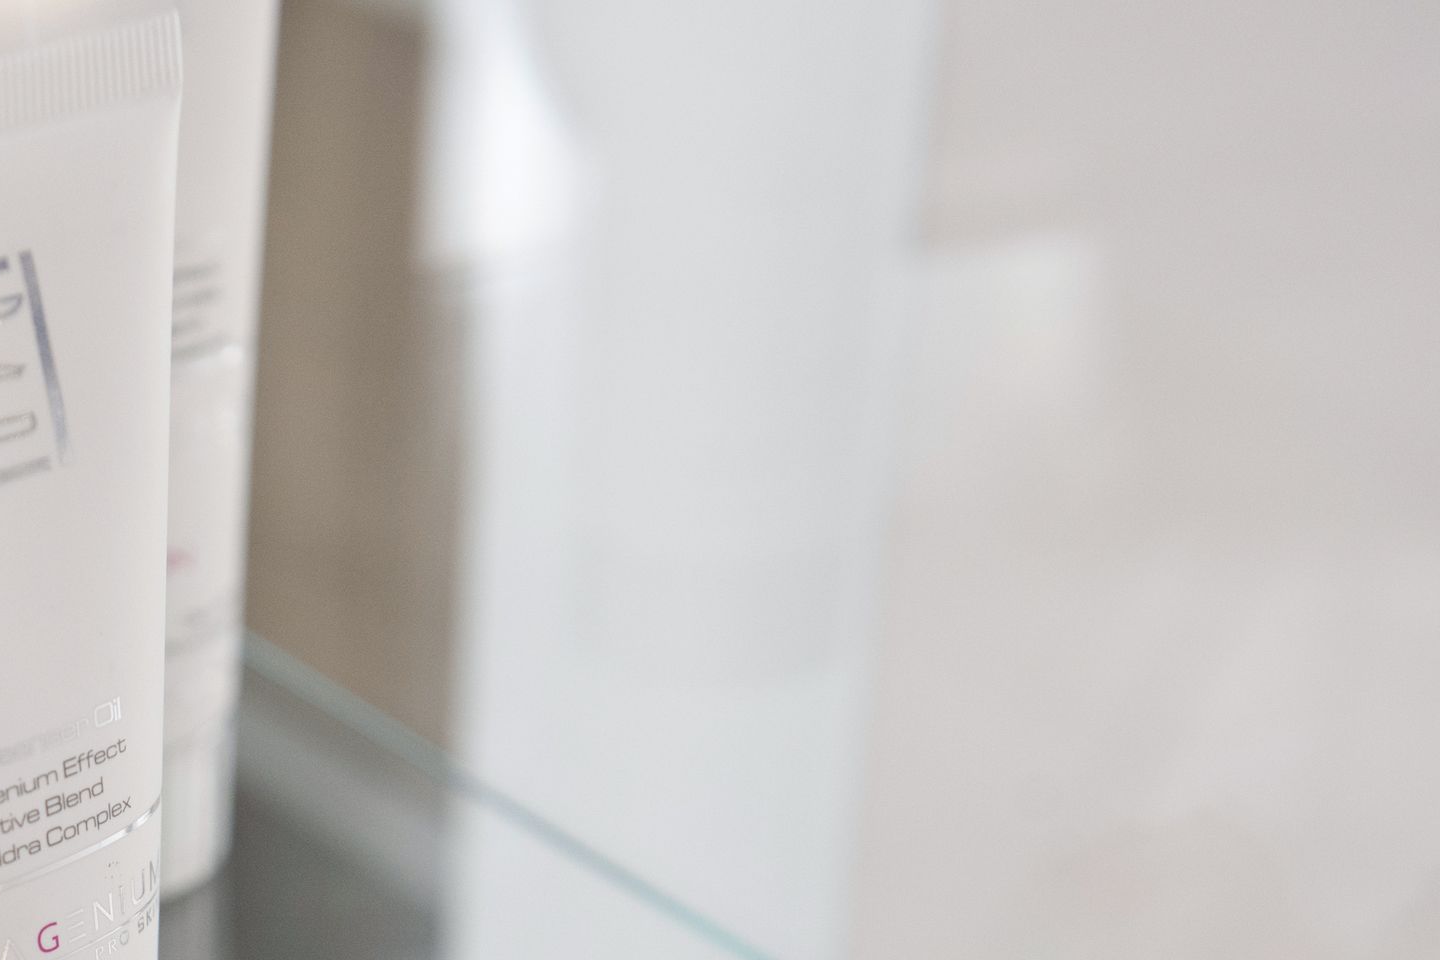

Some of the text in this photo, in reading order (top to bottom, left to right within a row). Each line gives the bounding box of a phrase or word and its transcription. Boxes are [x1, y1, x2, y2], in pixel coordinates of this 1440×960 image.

[94, 696, 122, 729] Oil
[62, 738, 127, 779] Effect
[44, 777, 105, 818] Blend
[46, 795, 133, 847] Complex
